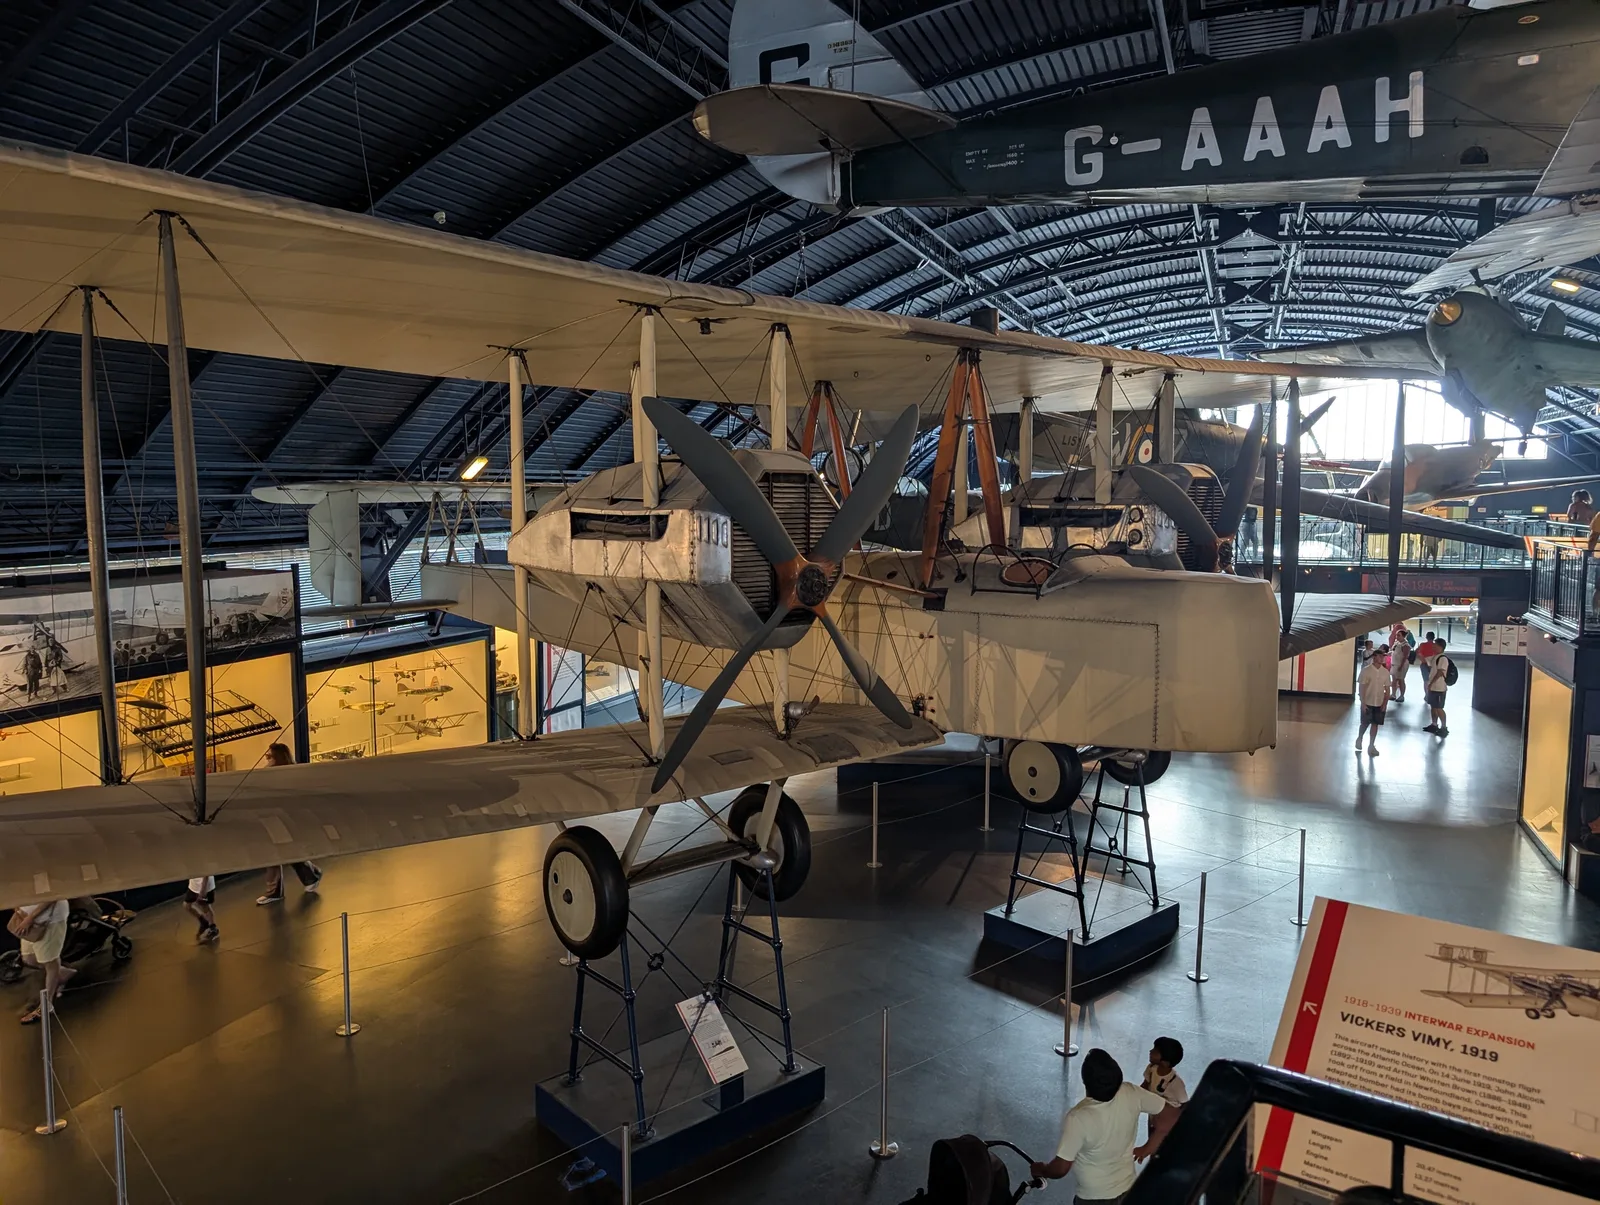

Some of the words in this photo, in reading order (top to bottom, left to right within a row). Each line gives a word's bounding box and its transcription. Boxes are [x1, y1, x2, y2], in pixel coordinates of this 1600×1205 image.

[1064, 71, 1424, 186] G-AAAH
[1412, 580, 1441, 591] 1945
[1340, 1011, 1407, 1038] VICKERS
[1411, 1030, 1455, 1052] VIMY,
[1460, 1044, 1499, 1063] 1919
[1404, 1010, 1463, 1032] INTERWAR
[1466, 1026, 1536, 1050] EXPANSION
[1332, 1043, 1356, 1053] across
[1371, 1052, 1400, 1065] Atlantic
[1401, 1061, 1427, 1073] Ocean.
[1428, 1068, 1439, 1076] On
[1451, 1074, 1471, 1084] June
[1494, 1085, 1516, 1097] John
[1516, 1092, 1545, 1105] Alcock
[1335, 1033, 1349, 1042] This
[1350, 1039, 1379, 1050] aircraft
[1379, 1047, 1401, 1056] made
[1402, 1052, 1429, 1065] history
[1430, 1060, 1447, 1069] with
[1449, 1065, 1462, 1073] the
[1464, 1069, 1481, 1078] first
[1482, 1074, 1516, 1088] nonstop
[1518, 1083, 1541, 1094] flight
[1376, 1064, 1392, 1072] and
[1392, 1067, 1417, 1079] Arthur
[1419, 1074, 1451, 1088] Whitten
[1452, 1083, 1477, 1096] Brown
[1326, 1067, 1358, 1080] adapted
[1359, 1076, 1389, 1089] bomber
[1390, 1085, 1405, 1094] had
[1406, 1089, 1417, 1097] its
[1418, 1093, 1441, 1104] bomb
[1442, 1099, 1461, 1110] bays
[1462, 1106, 1494, 1119] packed
[1495, 1115, 1514, 1125] with
[1515, 1120, 1532, 1130] fuel
[1328, 1058, 1345, 1067] took
[1347, 1063, 1359, 1071] off
[1359, 1067, 1377, 1077] from
[1385, 1074, 1403, 1084] field
[1474, 1099, 1508, 1114] Canada.
[1510, 1109, 1527, 1119] This
[1308, 1139, 1331, 1151] Length
[1311, 1129, 1343, 1144] Wingspan
[1303, 1159, 1334, 1175] Materials
[1335, 1170, 1349, 1179] and
[1348, 1175, 1371, 1185] const
[1305, 1149, 1329, 1161] Engine
[1301, 1170, 1331, 1184] Capacity
